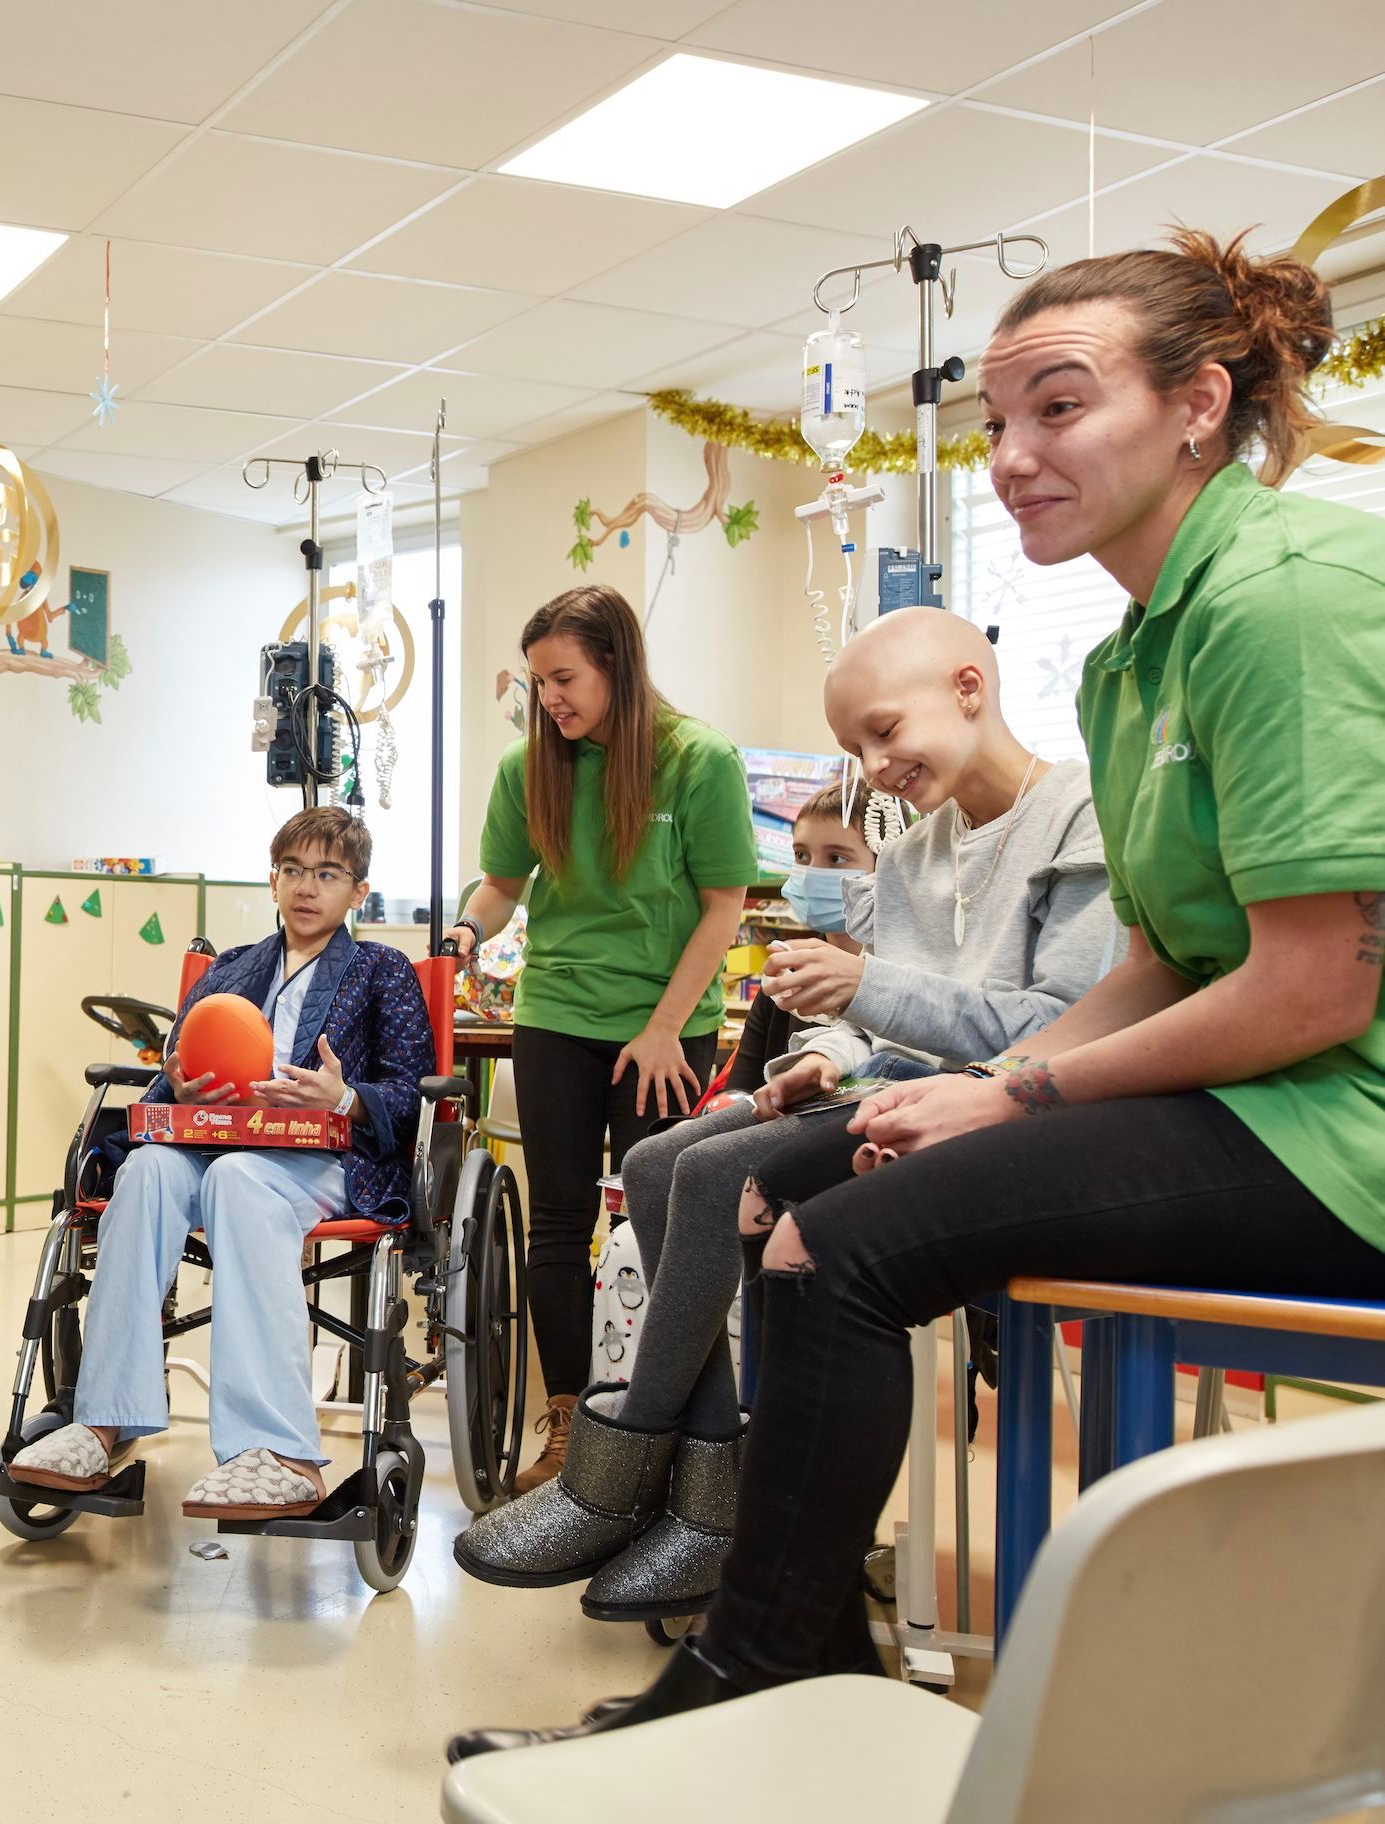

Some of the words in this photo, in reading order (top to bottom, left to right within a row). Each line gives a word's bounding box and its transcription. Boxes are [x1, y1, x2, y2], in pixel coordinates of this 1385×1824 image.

[246, 1109, 264, 1135] 4
[264, 1121, 286, 1136] em
[288, 1120, 322, 1137] linha
[183, 1128, 194, 1139] 2
